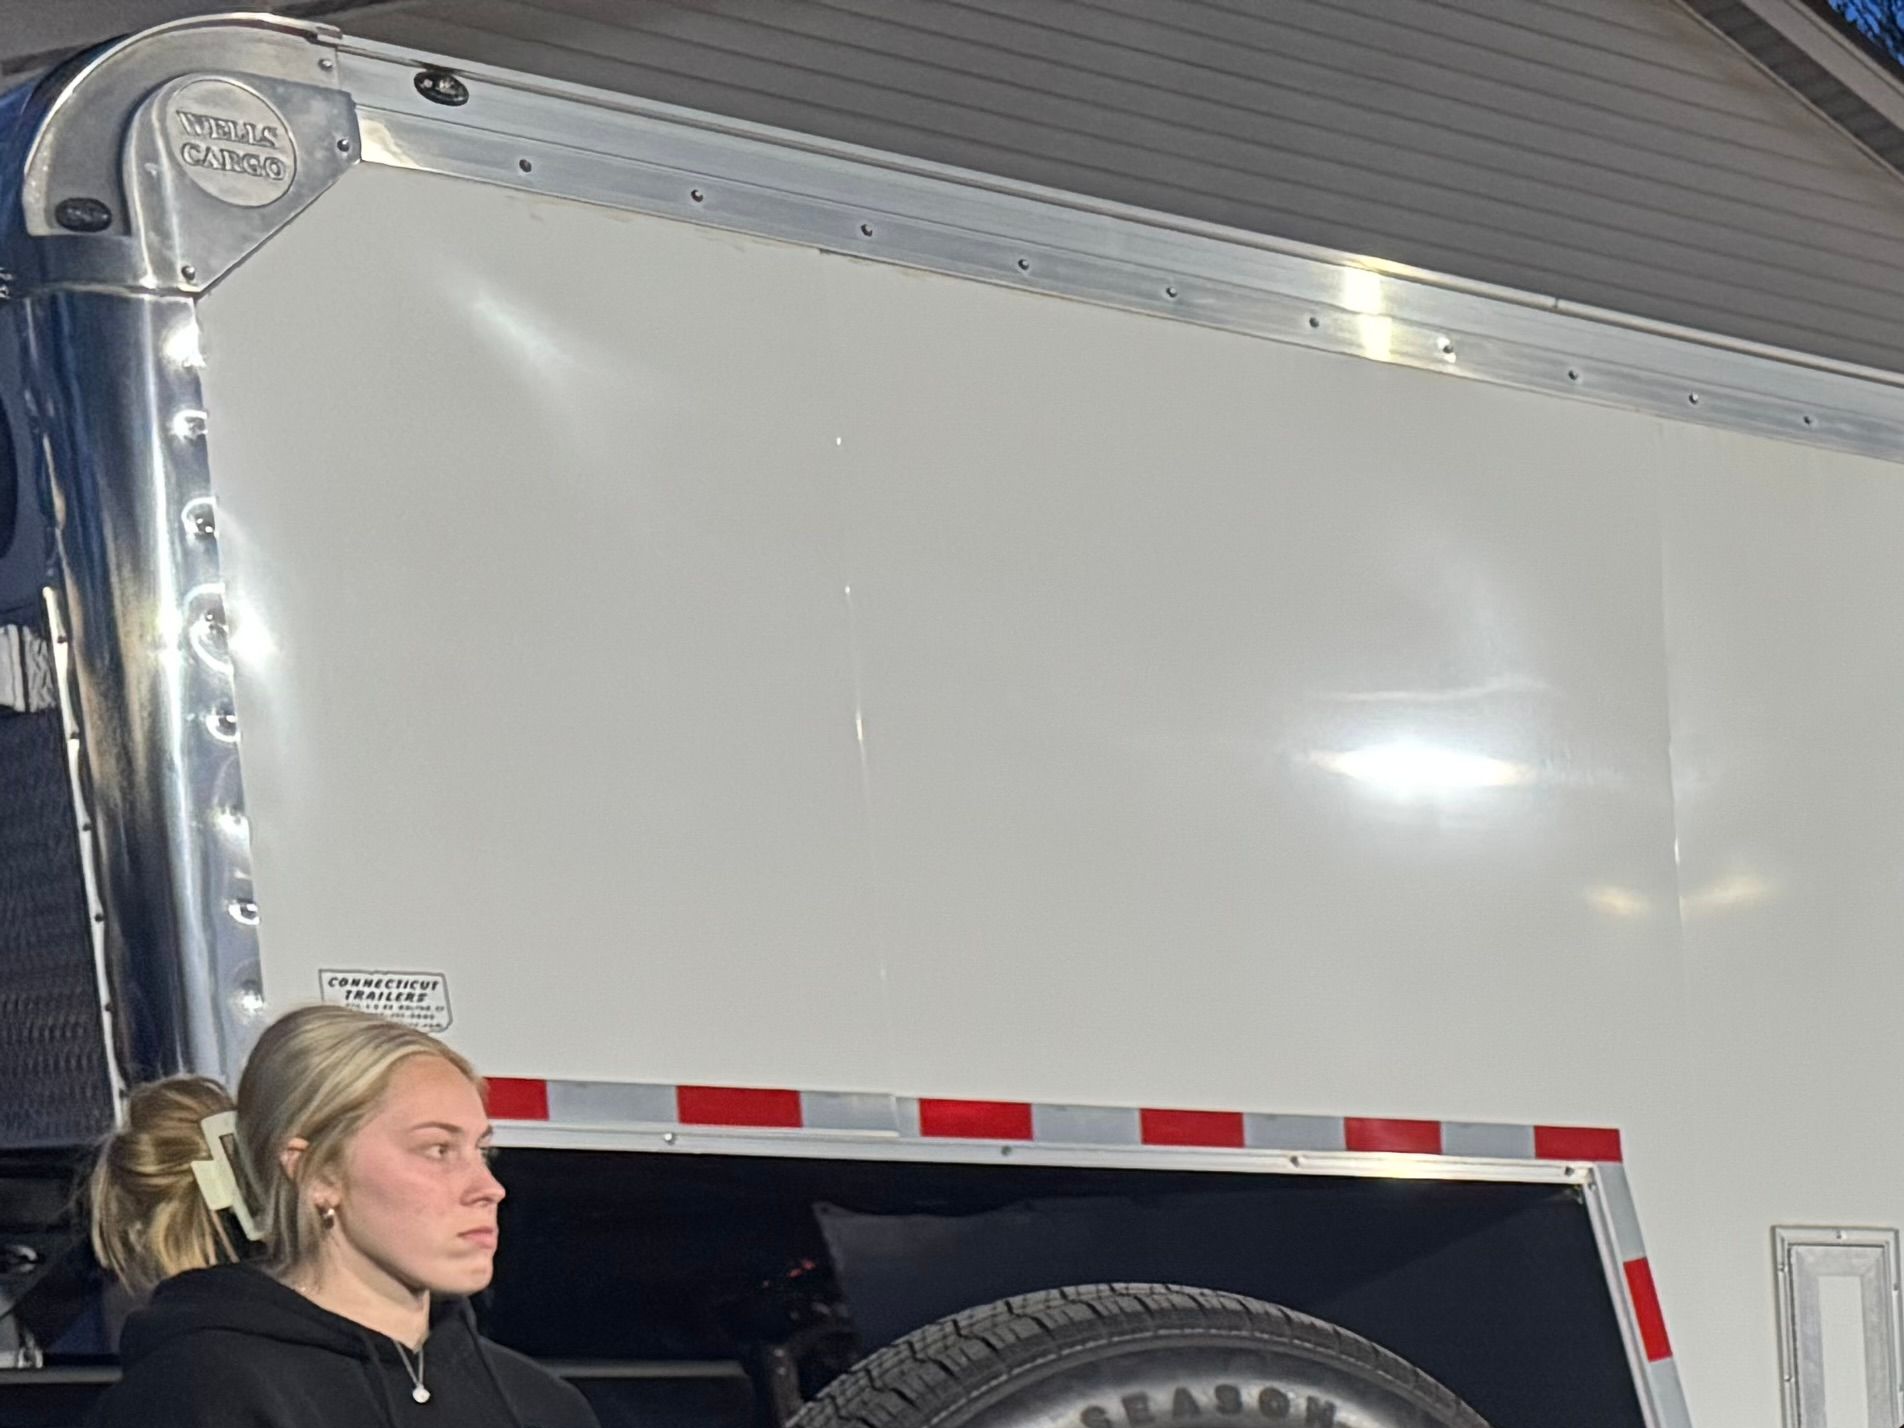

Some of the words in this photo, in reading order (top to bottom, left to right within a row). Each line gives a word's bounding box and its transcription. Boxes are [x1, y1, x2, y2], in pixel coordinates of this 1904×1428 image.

[176, 110, 278, 149] WELLS
[181, 142, 287, 181] CARGO
[327, 976, 440, 991] CONNECTICUT
[345, 989, 428, 1003] TRAILERS
